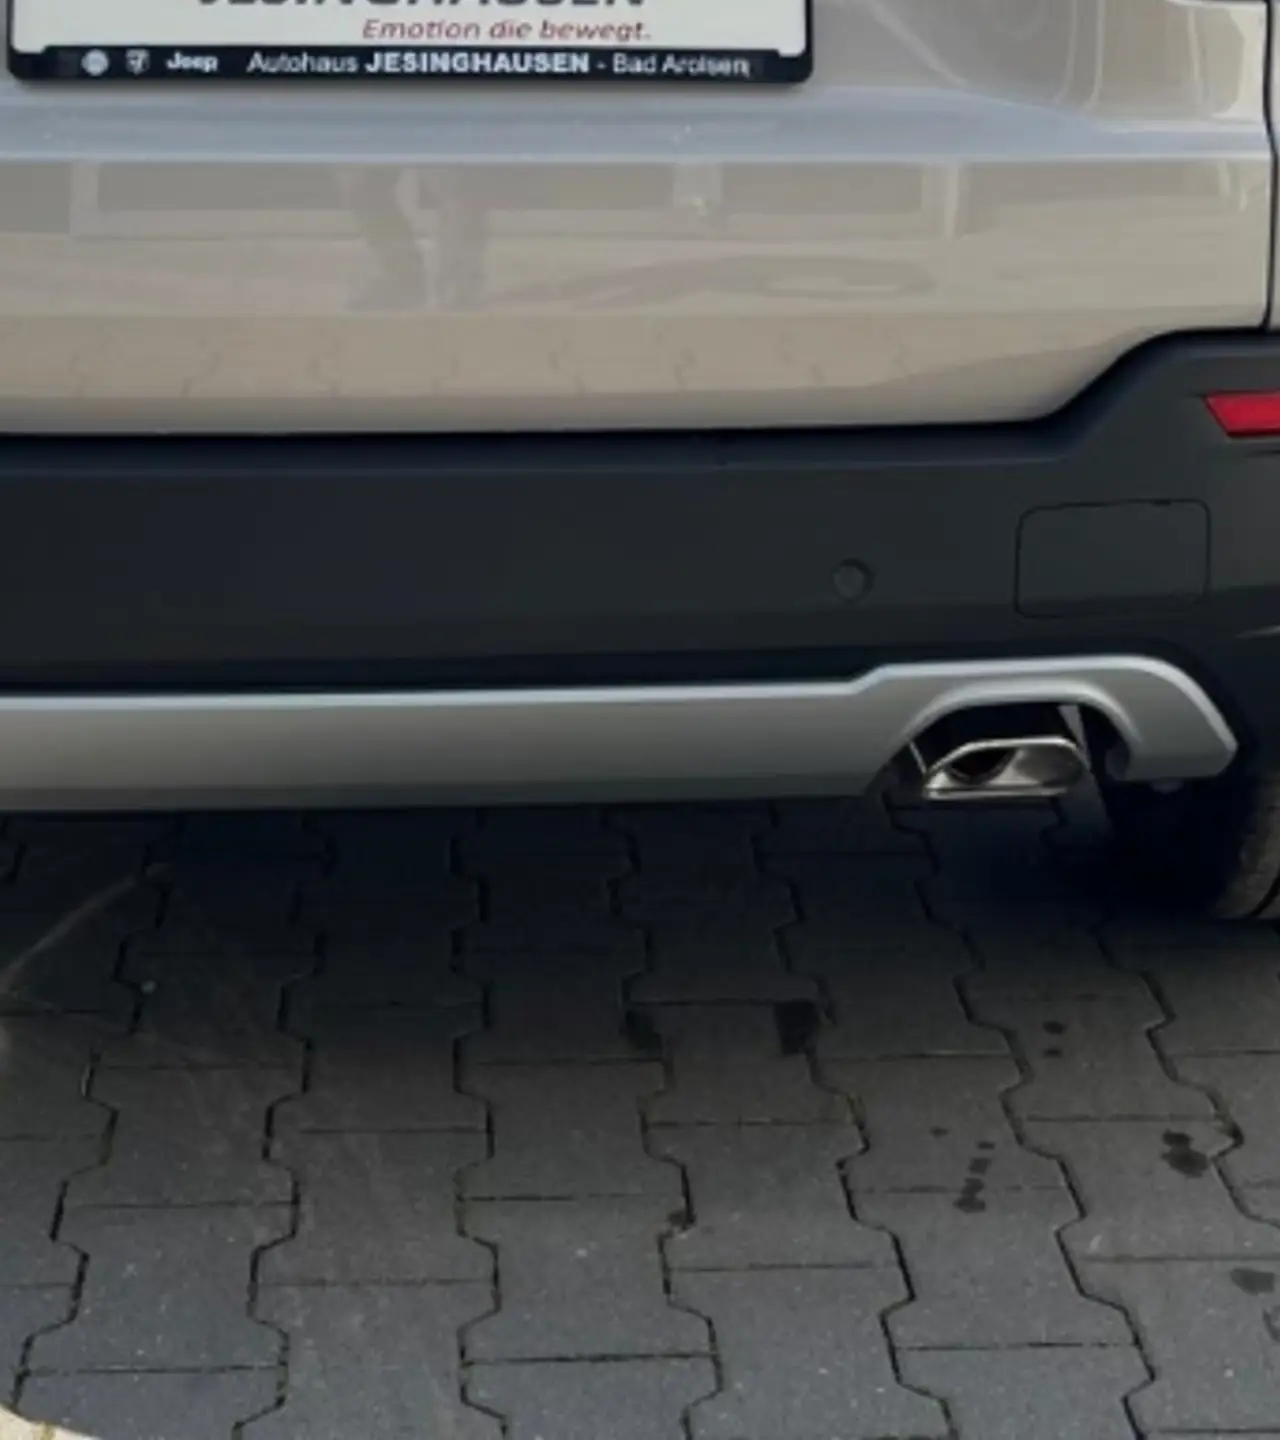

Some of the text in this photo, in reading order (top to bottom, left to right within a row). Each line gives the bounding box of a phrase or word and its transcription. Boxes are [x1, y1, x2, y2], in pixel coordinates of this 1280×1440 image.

[362, 17, 652, 43] Emotion die bewegt.
[166, 52, 219, 74] Jeep
[246, 51, 358, 73] Autohaus
[365, 51, 590, 73] JESINGHAUSEN
[613, 52, 657, 74] Bad
